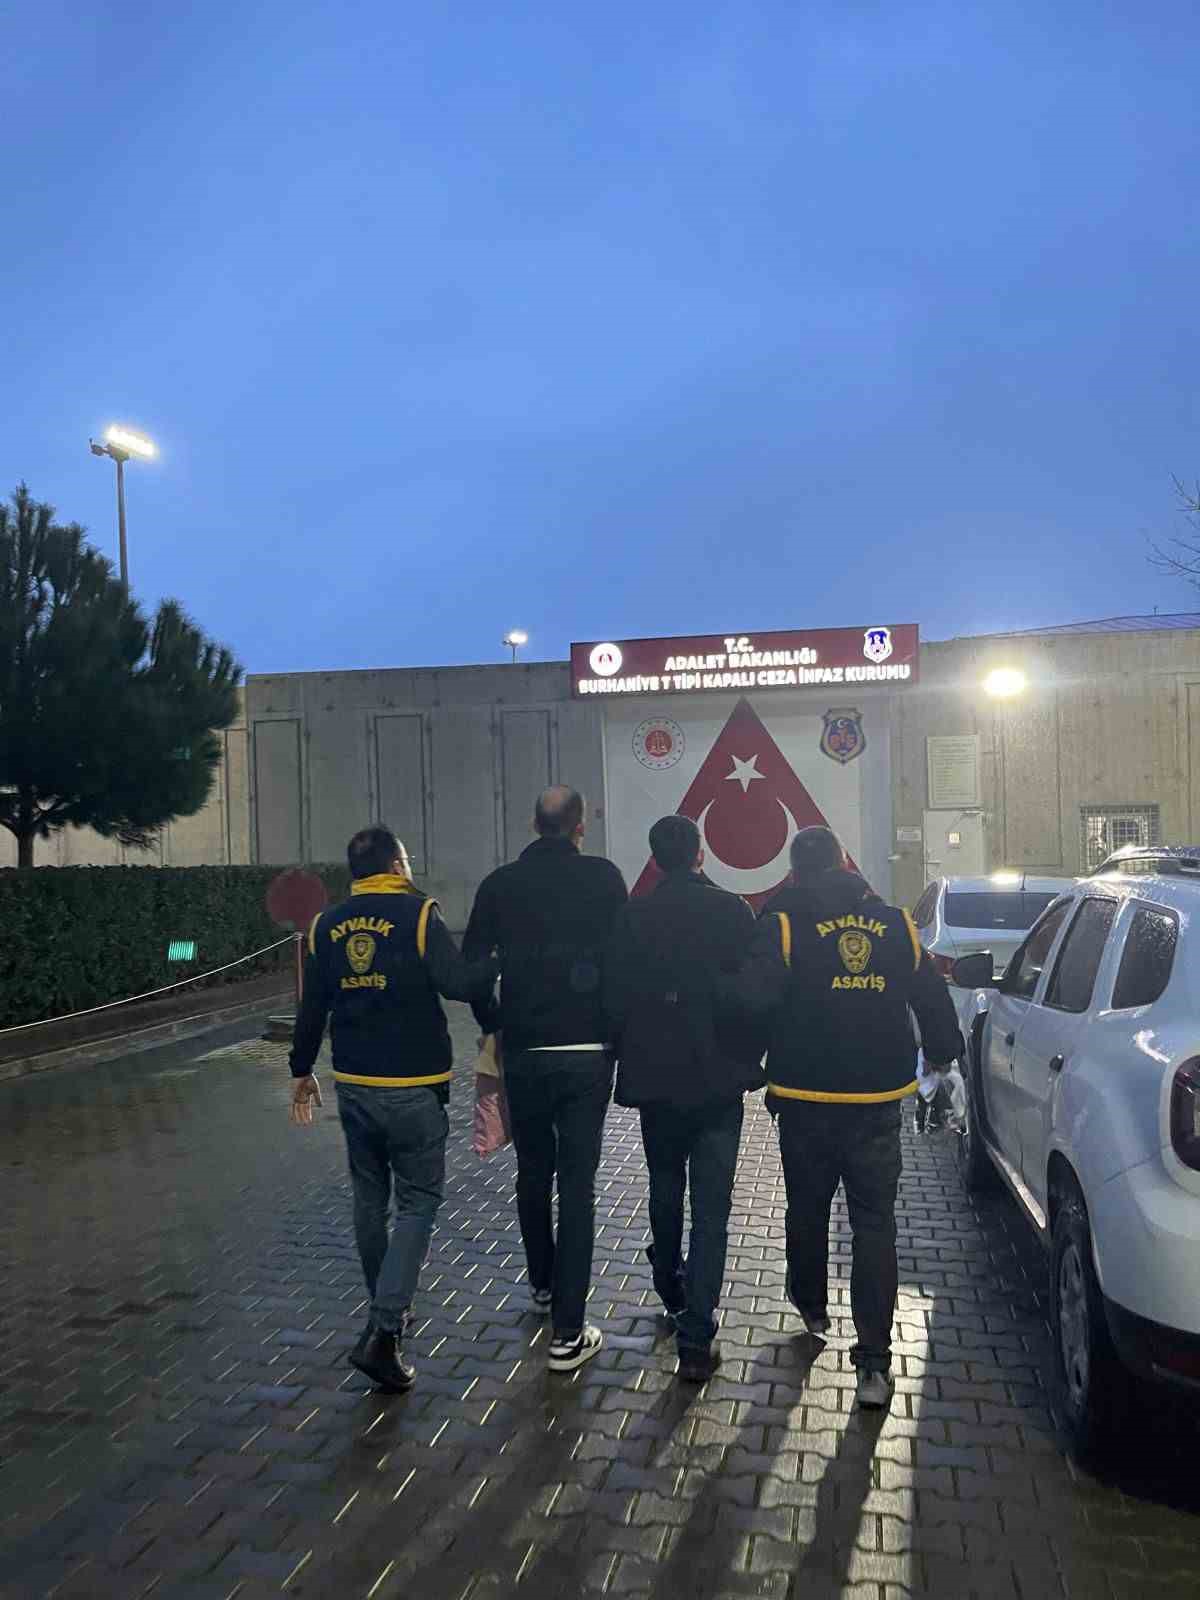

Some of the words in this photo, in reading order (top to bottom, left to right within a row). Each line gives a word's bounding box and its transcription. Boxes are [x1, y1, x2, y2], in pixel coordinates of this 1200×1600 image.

[724, 637, 754, 653] T.C.
[665, 653, 726, 671] ADALET
[729, 647, 817, 668] BAKANLIĞI
[578, 675, 660, 693] BURHANİYE
[660, 676, 671, 690] T
[672, 672, 700, 689] TİPİ
[703, 671, 755, 688] KAPALI
[757, 669, 797, 685] CEZA
[799, 666, 843, 684] İNFAZ
[845, 664, 910, 682] KURUMU
[330, 917, 395, 943] AYVALIK
[816, 914, 887, 937] AYVALIK
[340, 971, 387, 990] ASAYİŞ
[831, 972, 886, 992] ASAYİŞ
